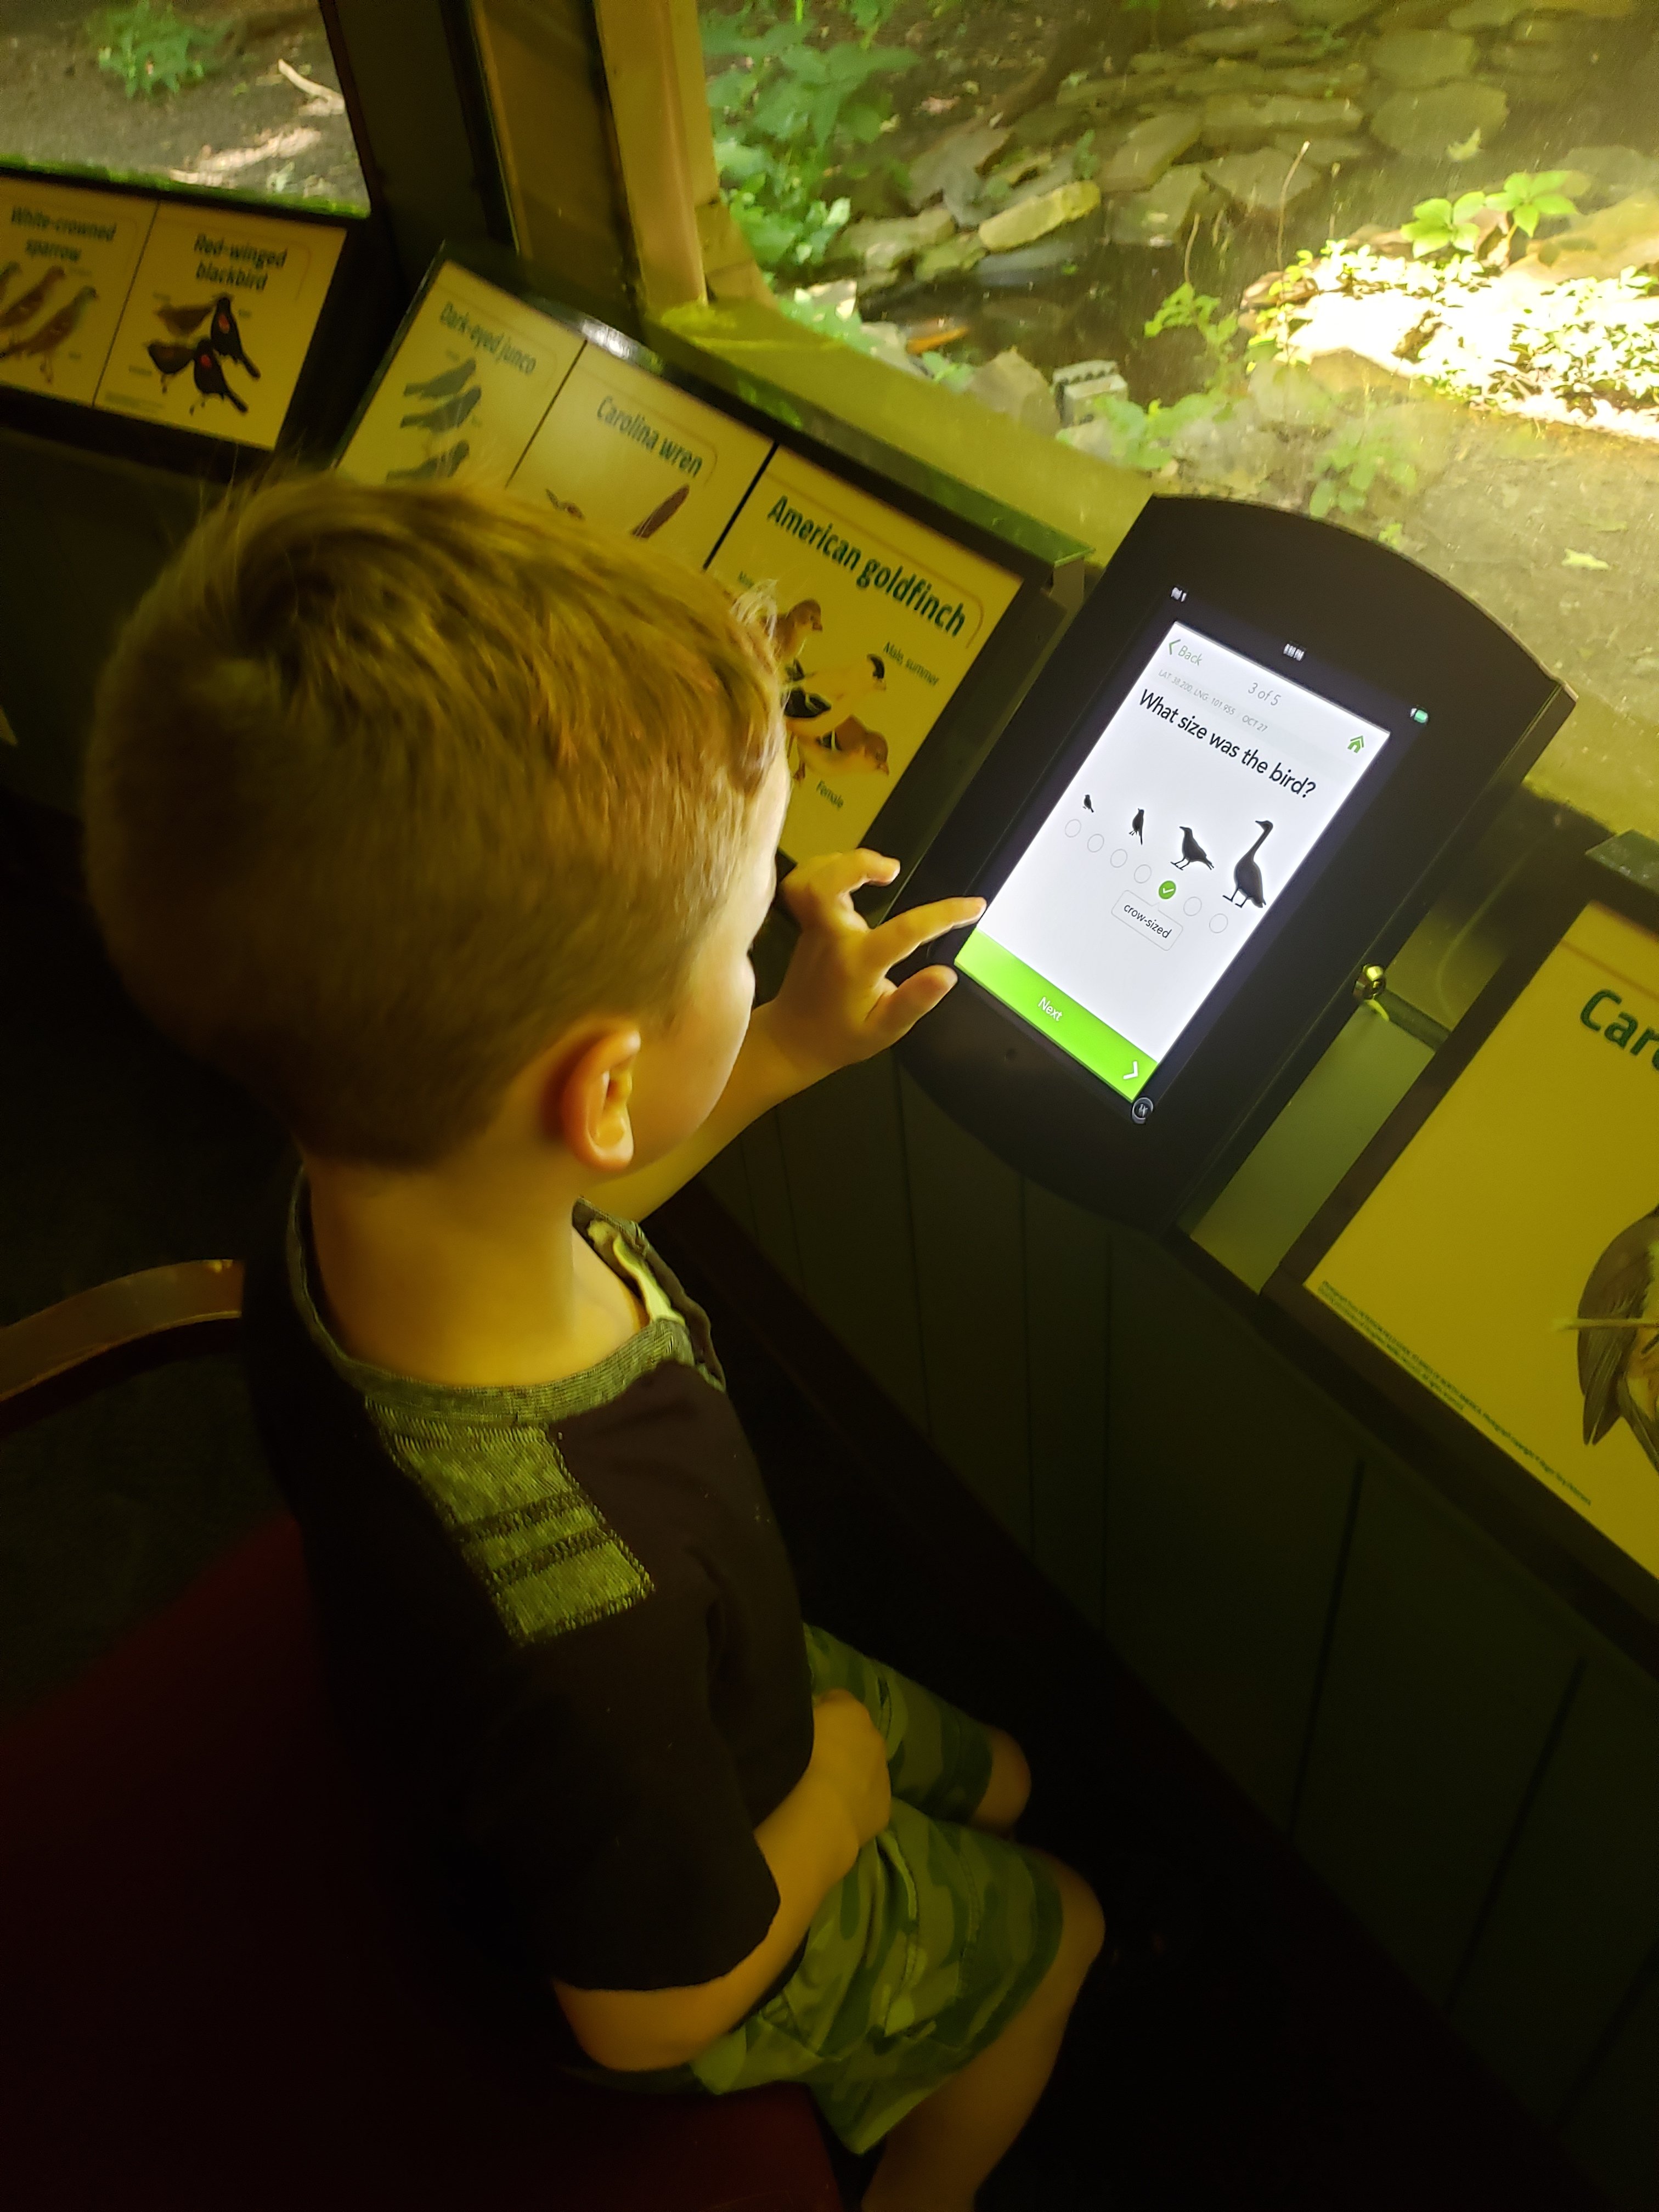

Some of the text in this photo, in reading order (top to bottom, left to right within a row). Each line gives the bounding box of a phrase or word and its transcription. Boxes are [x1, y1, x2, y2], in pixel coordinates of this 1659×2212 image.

[194, 233, 288, 269] Red-winged
[196, 260, 268, 290] blackbird
[440, 301, 504, 353] Dark-eyed
[597, 395, 702, 478] Carolina wren
[767, 494, 966, 637] American goldfinch
[1177, 645, 1203, 666] Back
[905, 658, 940, 686] summer
[1248, 682, 1282, 706] 3 of 5
[1242, 714, 1259, 727] OCT
[1256, 723, 1268, 733] 27
[1139, 689, 1316, 798] What size was the bird?
[816, 780, 844, 809] Female
[1123, 905, 1172, 939] crow-sized
[1037, 996, 1063, 1022] Next
